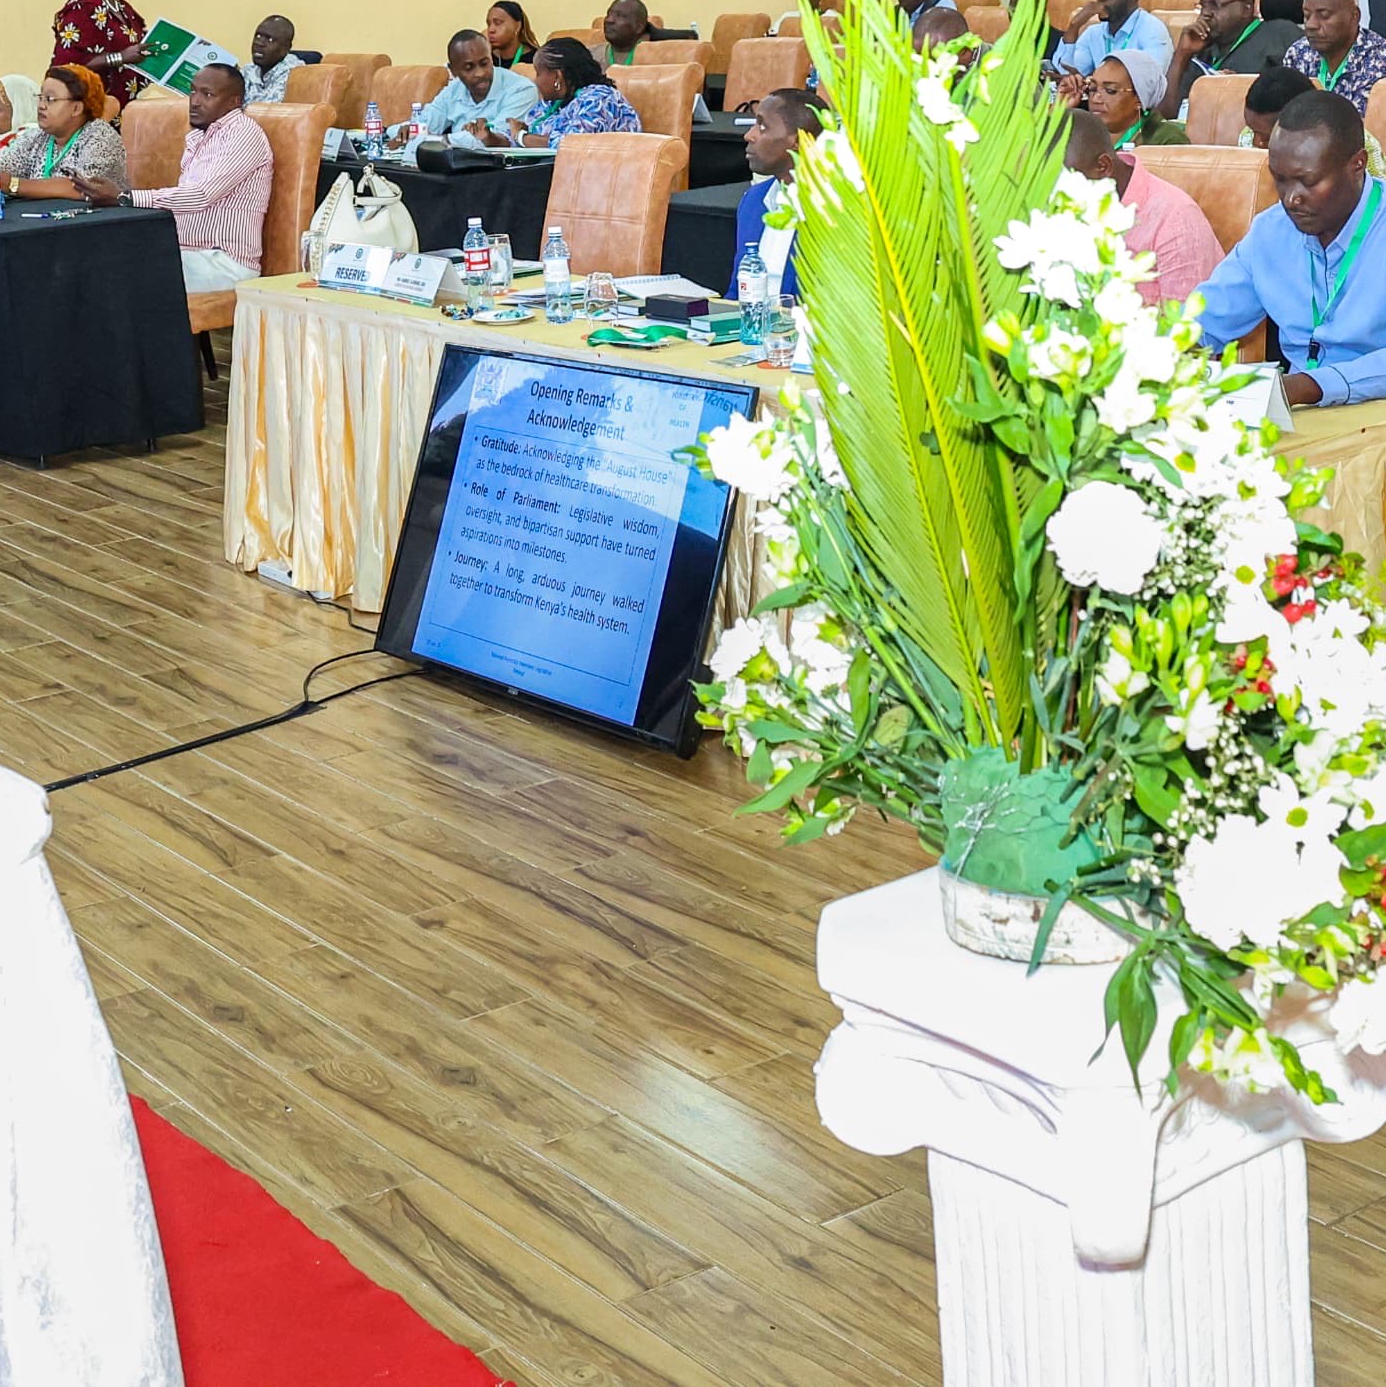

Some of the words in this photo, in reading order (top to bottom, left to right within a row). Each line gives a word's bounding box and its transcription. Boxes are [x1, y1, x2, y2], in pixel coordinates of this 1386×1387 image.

[530, 381, 574, 406] Opening
[576, 388, 621, 411] Remarks
[625, 395, 634, 412] &
[527, 409, 626, 441] Acknowledgement
[476, 458, 485, 469] as
[487, 458, 500, 474] the
[501, 461, 532, 480] bedrock
[534, 468, 545, 482] of
[544, 470, 589, 493] healthcare
[589, 482, 657, 507] transformation.
[481, 435, 521, 455] Gratitude:
[522, 443, 585, 471] Acknowledging
[586, 454, 601, 471] the
[640, 465, 673, 485] House"
[465, 505, 502, 525] oversight,
[505, 514, 522, 528] and
[522, 516, 563, 537] bipartisan
[565, 528, 599, 548] support
[601, 534, 622, 553] have
[625, 542, 656, 561] turned
[470, 481, 489, 497] Role
[496, 487, 507, 501] of
[513, 491, 561, 514] Parliament:
[569, 504, 613, 527] Legislative
[623, 518, 660, 539] wisdom,
[460, 526, 502, 547] aspirations
[503, 535, 520, 551] into
[521, 541, 567, 564] milestones.
[450, 572, 483, 592] together
[483, 582, 493, 596] to
[494, 585, 534, 607] transform
[534, 596, 566, 617] Kenya's
[567, 604, 595, 624] health
[597, 613, 630, 635] system.
[454, 550, 488, 573] Journey:
[493, 560, 500, 574] A
[505, 563, 525, 584] long,
[531, 573, 566, 592] arduous
[571, 582, 606, 607] journey
[612, 594, 645, 614] walked
